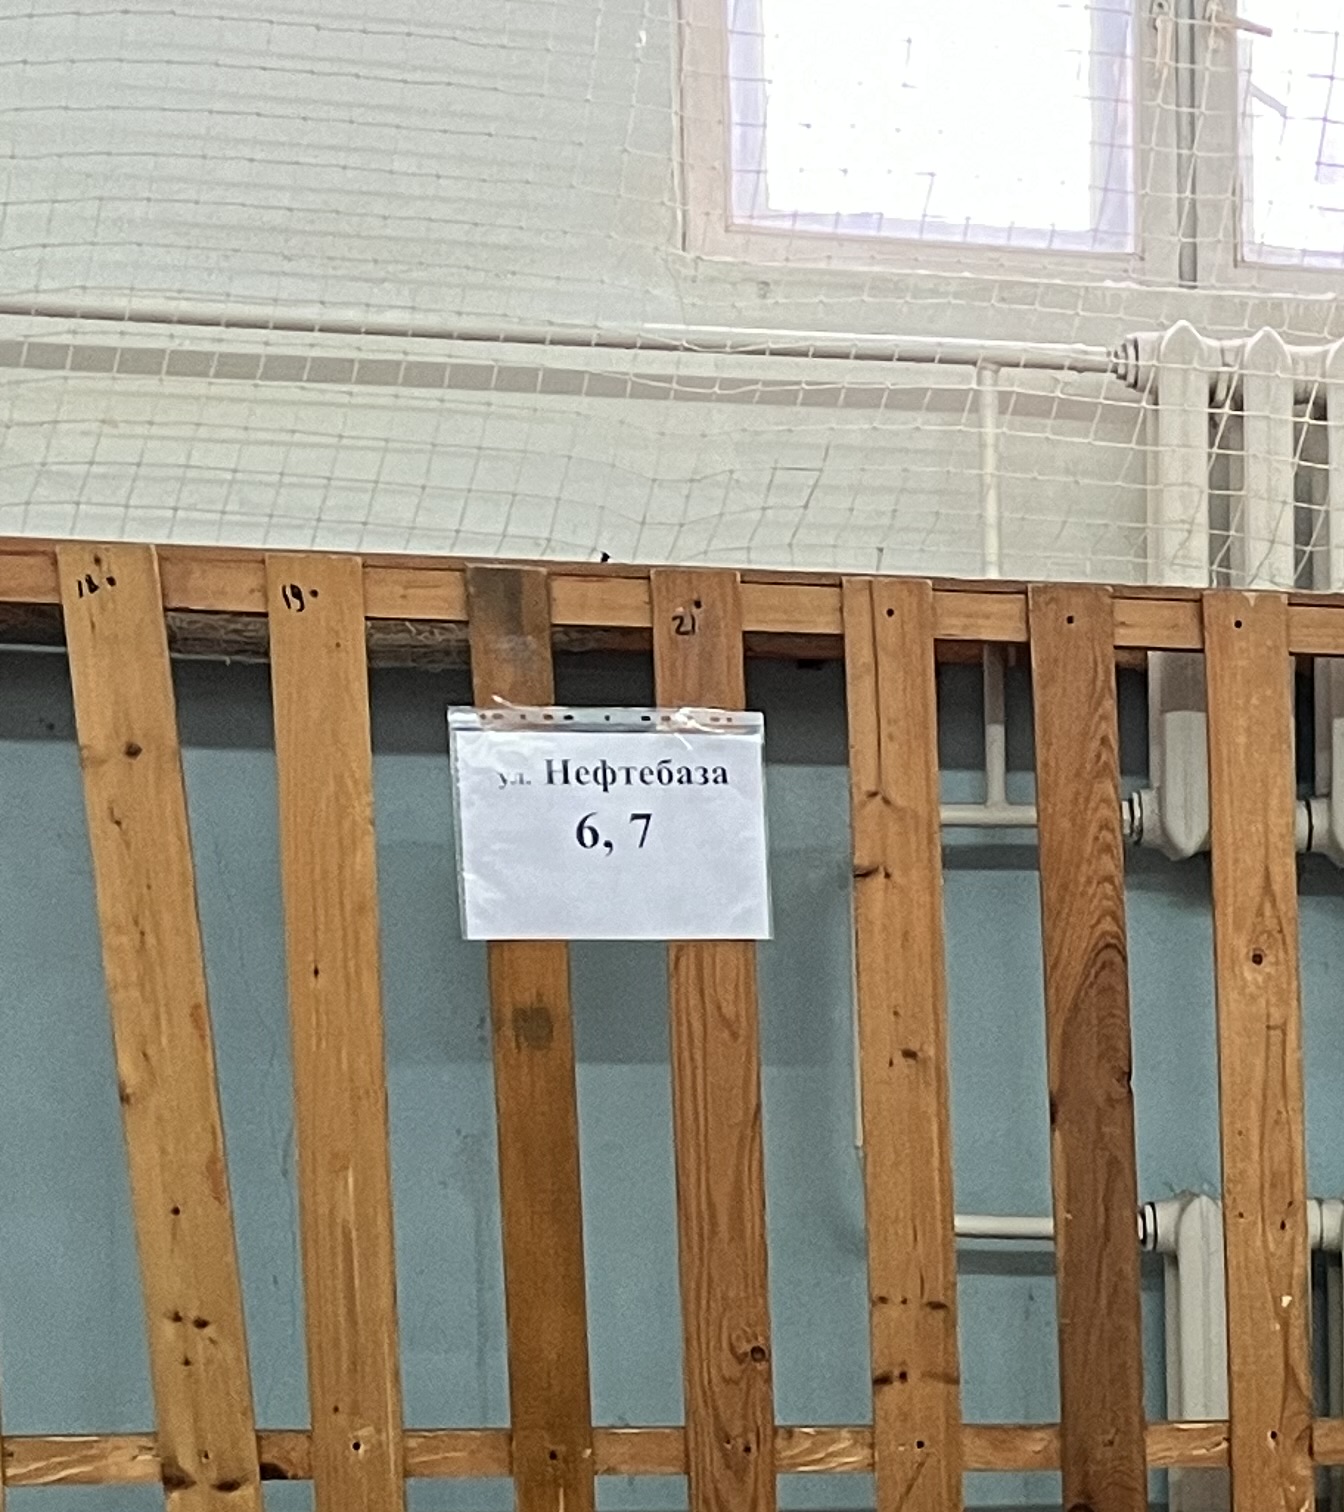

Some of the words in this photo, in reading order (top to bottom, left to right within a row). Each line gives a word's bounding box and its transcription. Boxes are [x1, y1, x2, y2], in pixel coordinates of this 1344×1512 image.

[496, 771, 532, 790] ул.
[544, 758, 729, 793] Нефтебаза
[575, 811, 614, 857] 6,
[629, 812, 653, 849] 7
